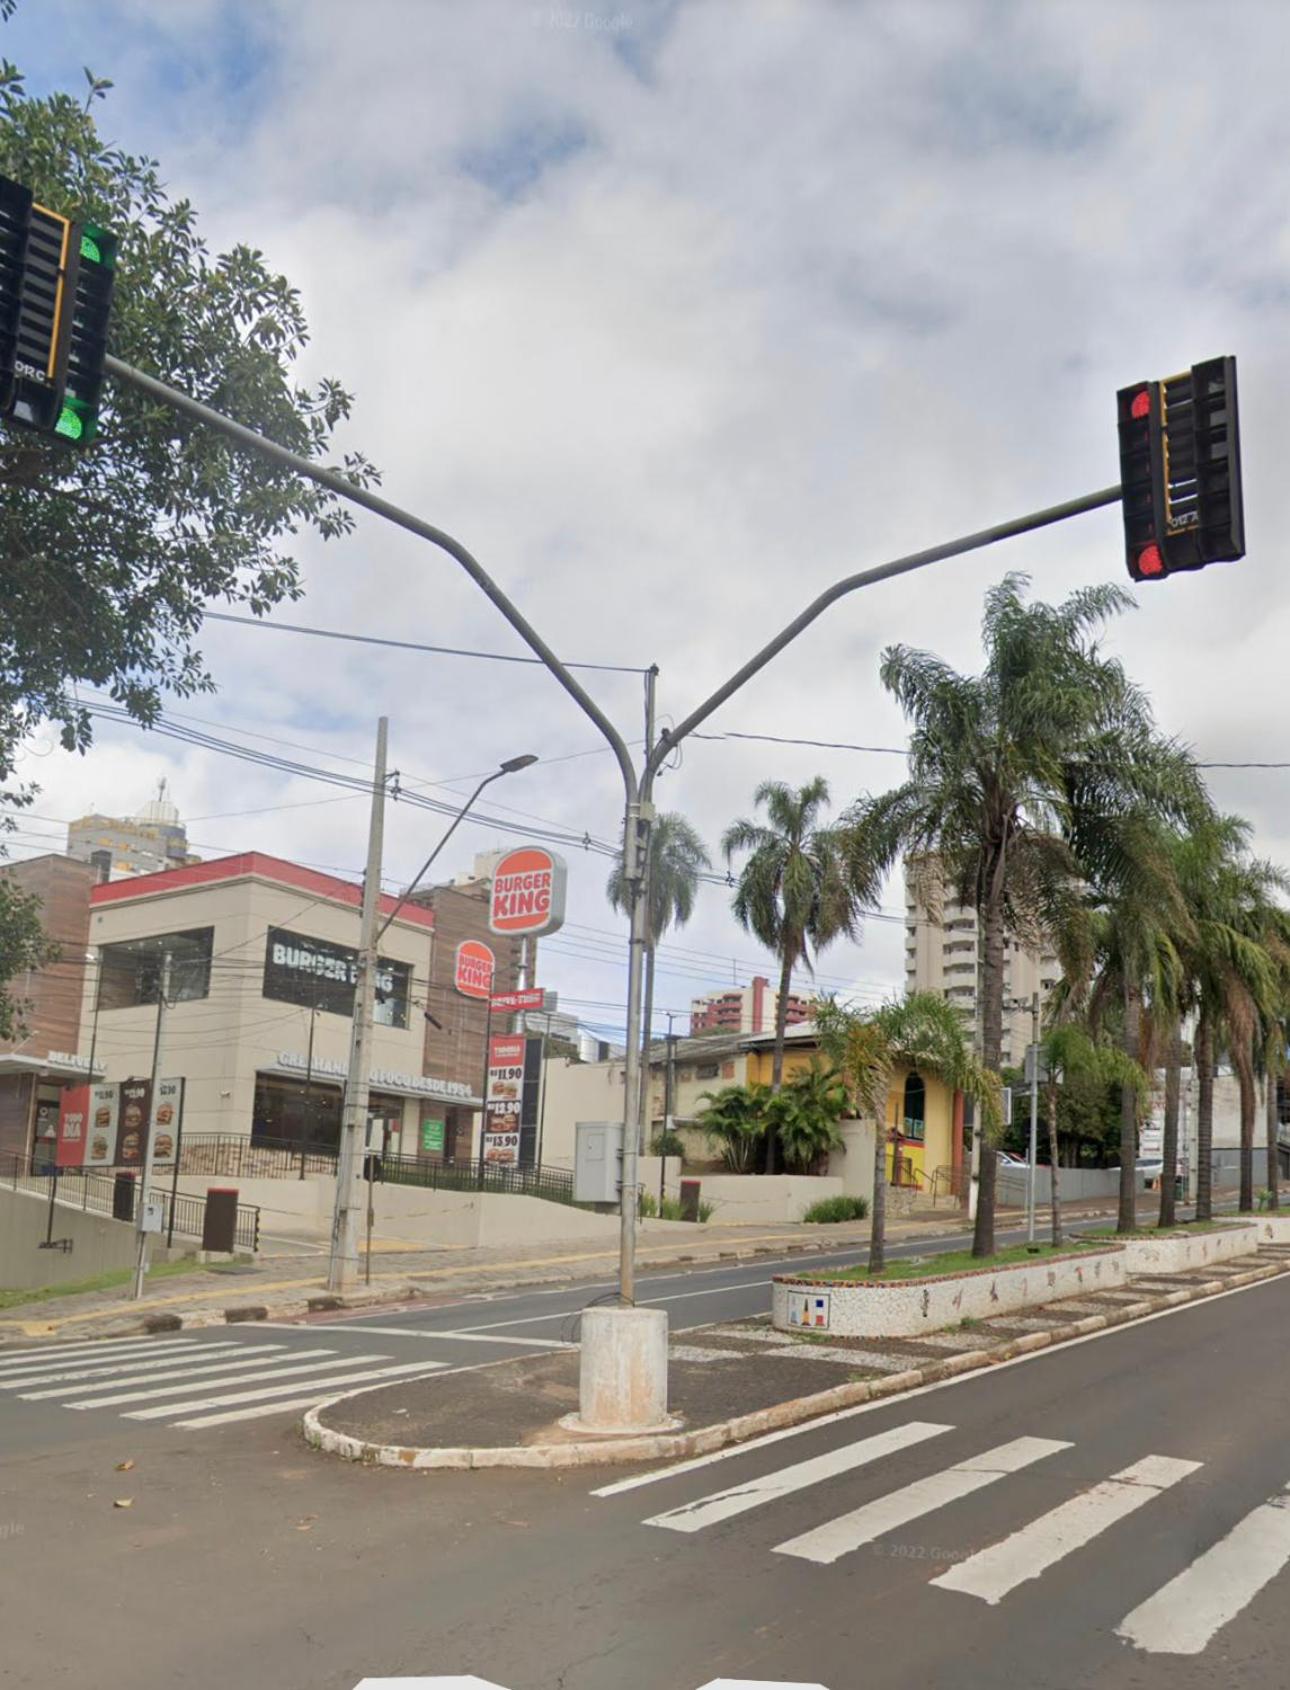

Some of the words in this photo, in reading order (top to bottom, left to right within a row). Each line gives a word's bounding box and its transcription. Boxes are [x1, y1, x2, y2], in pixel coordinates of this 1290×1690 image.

[494, 872, 551, 894] BURGER
[492, 889, 551, 918] KING
[272, 943, 347, 982] BURGER
[458, 953, 493, 973] BURGER
[457, 966, 491, 989] KING
